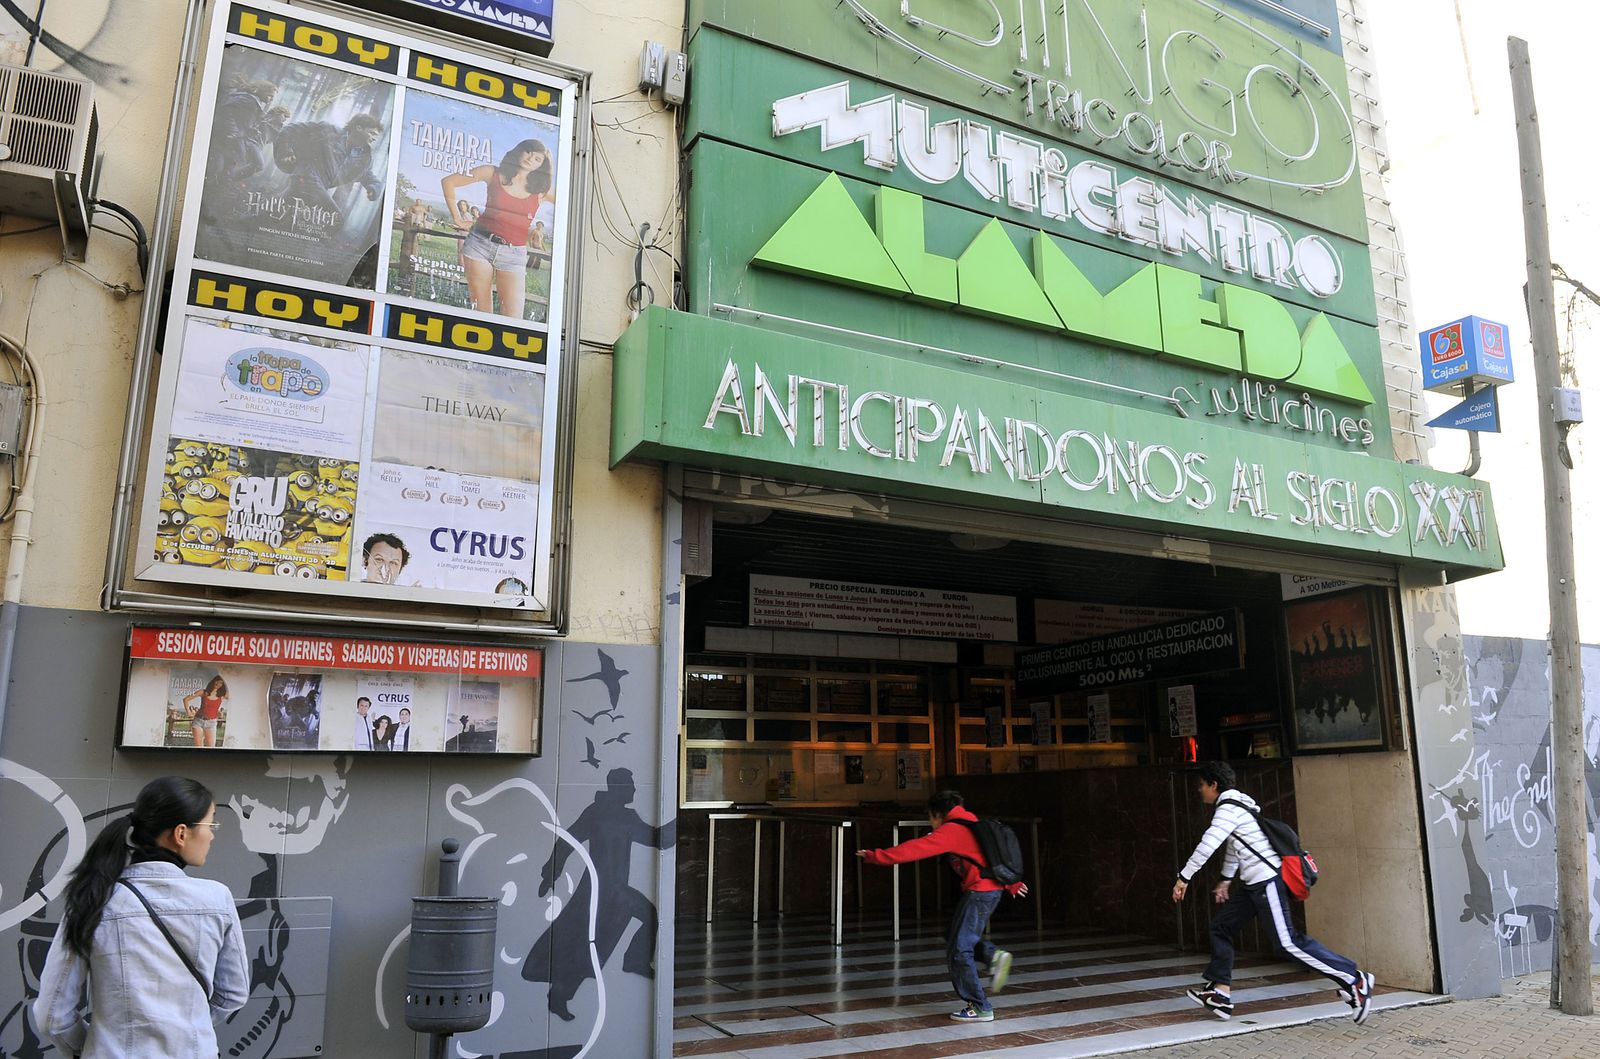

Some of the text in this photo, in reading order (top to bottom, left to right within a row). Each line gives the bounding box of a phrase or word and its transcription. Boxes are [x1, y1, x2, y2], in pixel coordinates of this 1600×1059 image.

[457, 0, 551, 35] ALAMEDA
[239, 11, 390, 65] HOY
[415, 57, 552, 109] HOY
[1012, 68, 1235, 183] TRICOLOR
[410, 119, 493, 163] TAMARA
[422, 149, 475, 178] DREWE
[410, 254, 465, 272] Stephen
[752, 170, 1376, 405] ALAMEDA
[195, 278, 360, 328] HOY
[400, 314, 543, 360] HOY
[250, 350, 312, 375] la tropa de
[1432, 361, 1469, 380] Cajasol
[1483, 358, 1509, 374] Cajasol
[237, 358, 323, 398] trapo
[245, 402, 271, 413] BRILLA
[284, 408, 300, 417] SOL
[257, 396, 287, 408] DONDE
[288, 402, 320, 414] SIEMPRE
[421, 395, 508, 422] THE WAY
[1469, 402, 1491, 413] Cajero
[1455, 410, 1493, 426] automático
[702, 357, 1217, 510] ANTICIPANDONOS
[1227, 456, 1282, 521] AL
[1286, 470, 1405, 538] SIGLO
[1409, 480, 1488, 552] XXI
[380, 475, 403, 483] REILLY
[461, 486, 481, 494] TOMEI
[229, 476, 290, 517] GRU
[502, 492, 526, 500] KEENER
[228, 510, 285, 531] MI VILLANO
[225, 523, 283, 549] FAVORITO
[430, 527, 526, 561] CYRUS
[180, 542, 215, 552] OCTUBRE
[226, 548, 249, 556] CINES
[261, 551, 306, 563] ALUCINANTE
[809, 582, 839, 592] PRECIO
[840, 584, 878, 594] ESPECIAL
[880, 588, 918, 598] REDUCIDO
[1300, 585, 1306, 595] A
[1307, 583, 1320, 593] 100
[157, 630, 528, 672] SESIÓN GOLFA SOLO VIERNES, SÁBADOS Y VÍSPERAS DE FESTIVOS
[1021, 651, 1051, 666] PRIMER
[1053, 642, 1089, 662] CENTRO
[1091, 640, 1104, 651] EN
[1106, 628, 1164, 651] ANDALUCIA
[1166, 615, 1225, 640] DEDICADO
[1018, 632, 1233, 682] EXCLUSIVAMENTE AL OCIO Y RESTAURACION
[171, 677, 203, 689] TAMARA
[1079, 670, 1116, 687] 5000
[1117, 667, 1145, 681] Mts
[377, 692, 410, 704] CYRUS
[461, 692, 475, 701] THE
[1472, 744, 1556, 850] The End
